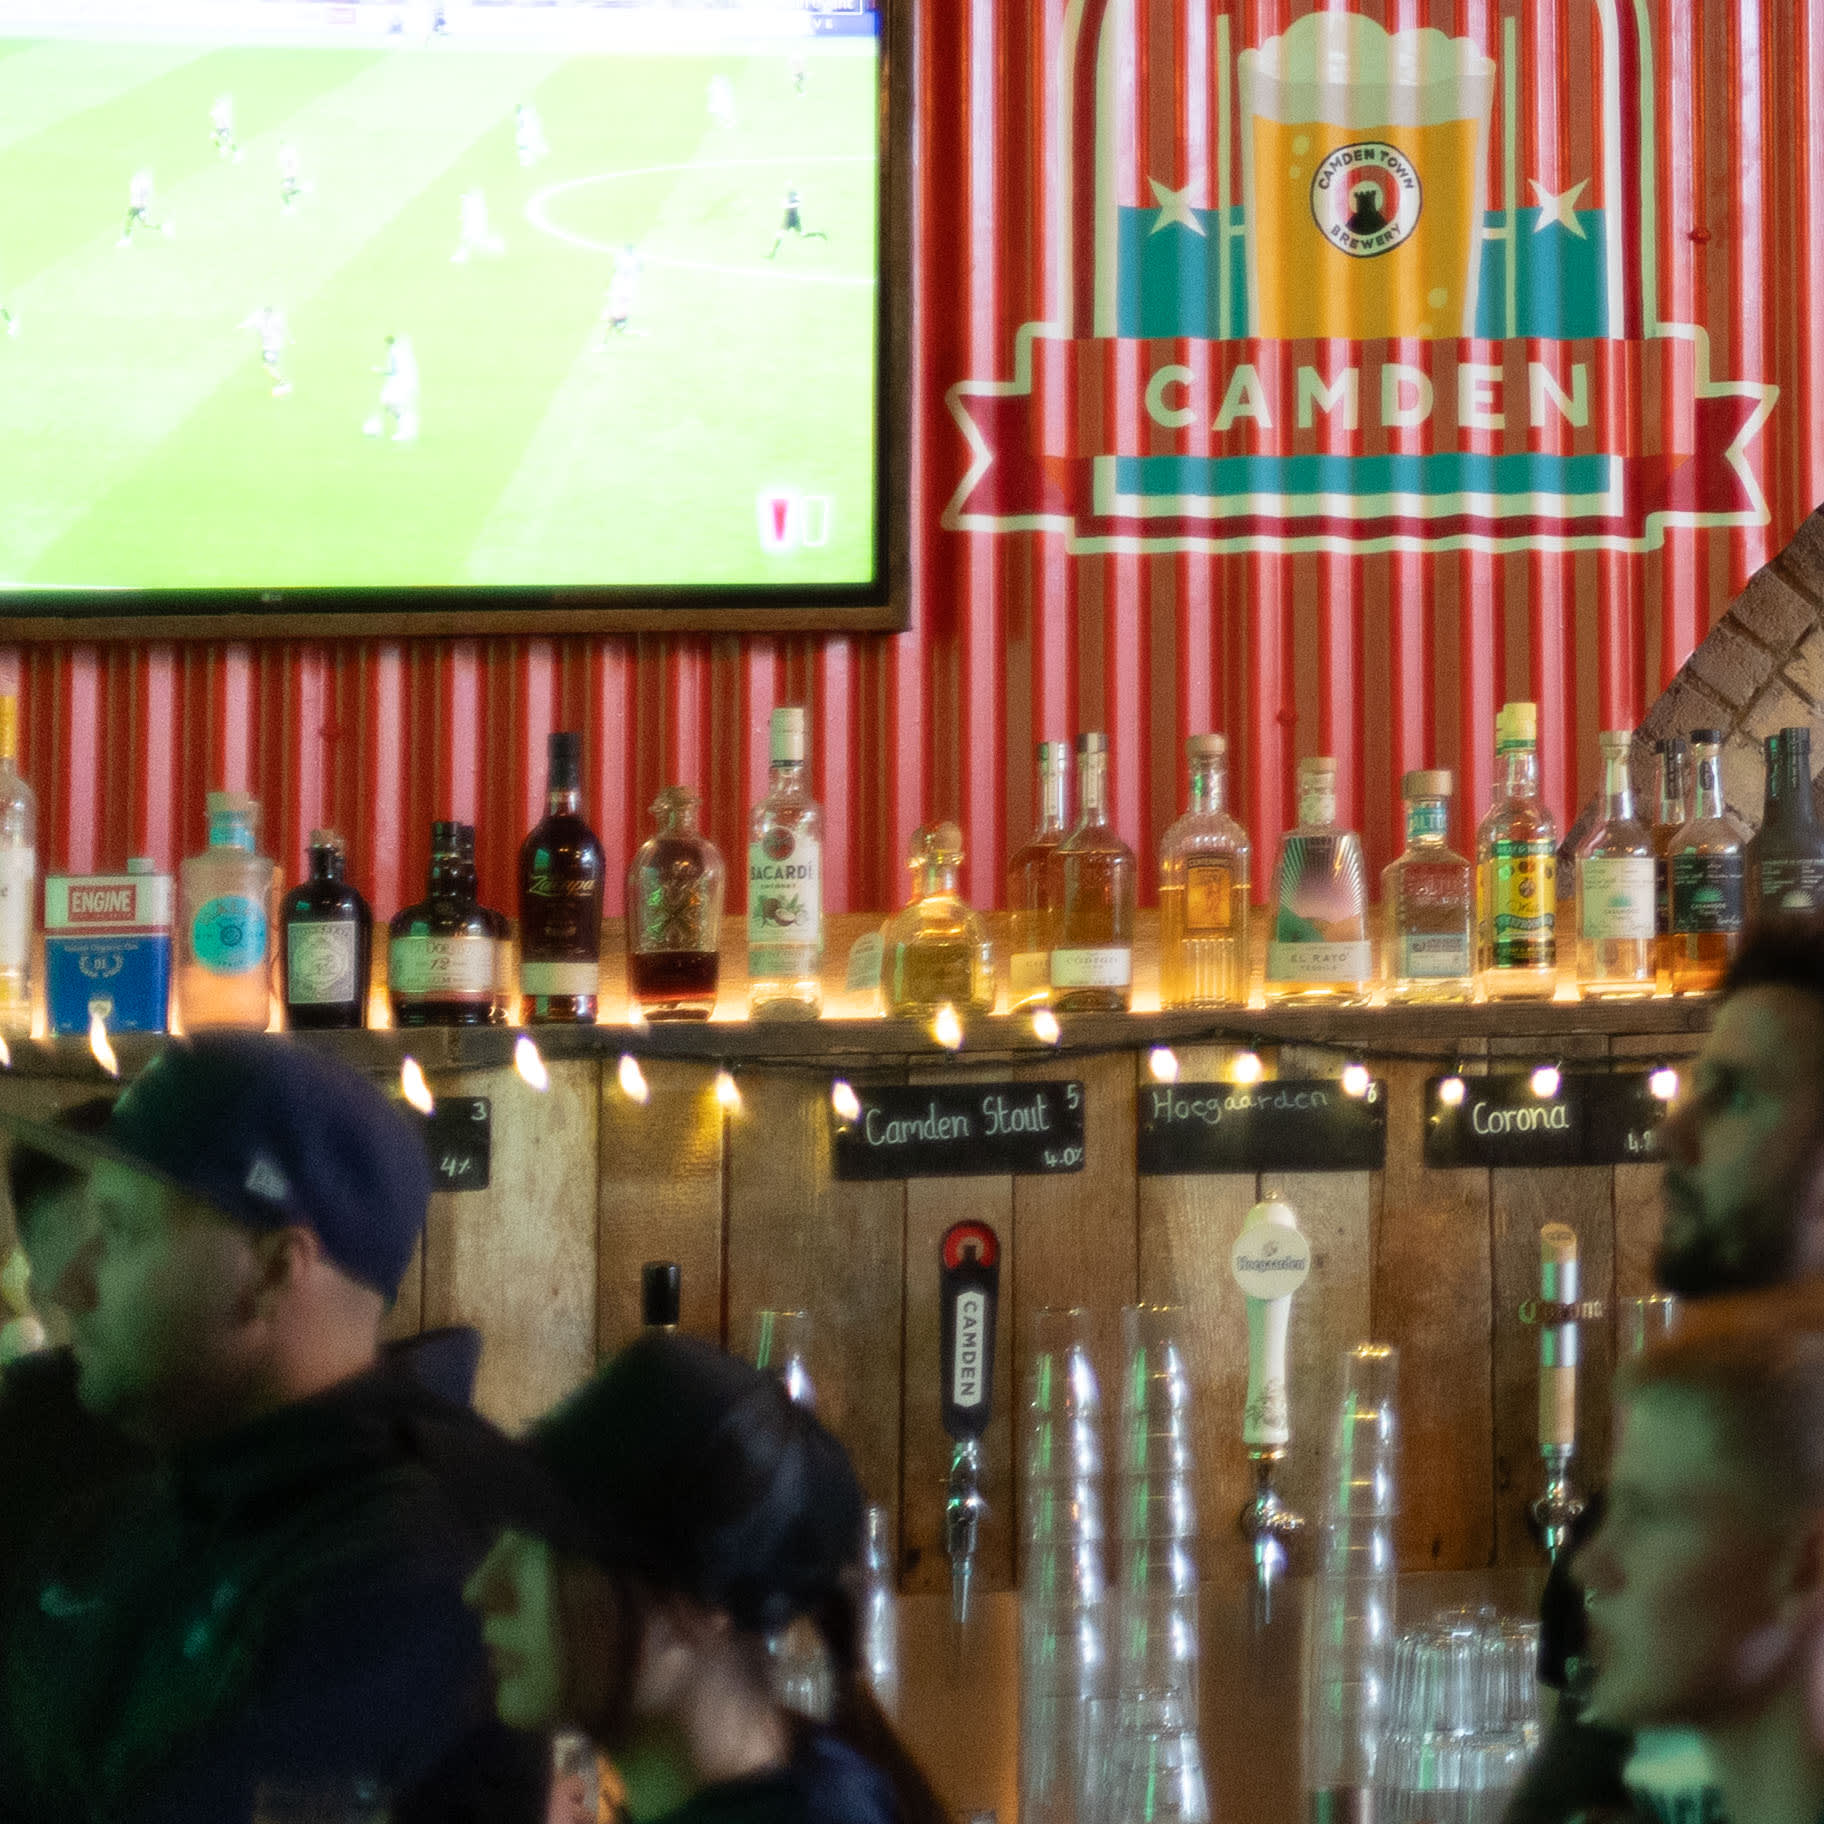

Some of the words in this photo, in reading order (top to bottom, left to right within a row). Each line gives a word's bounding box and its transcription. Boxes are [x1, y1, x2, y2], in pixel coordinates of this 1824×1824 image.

[1318, 148, 1375, 191] CAMDEN
[1380, 150, 1414, 189] TOWN
[1330, 223, 1402, 249] BREWERY
[1145, 363, 1589, 432] CAMDEN
[71, 889, 131, 914] ENGINE
[1290, 954, 1308, 964] EL
[1312, 952, 1346, 964] RAYO
[470, 1101, 487, 1121] 3
[866, 1102, 969, 1146] Camden
[982, 1093, 1050, 1135] Stout
[1066, 1083, 1079, 1109] 5
[1152, 1089, 1328, 1124] Hoegaarden
[1472, 1101, 1570, 1135] Corona
[1044, 1146, 1083, 1167] 4.0%
[1238, 1256, 1306, 1272] Hoegaarden
[960, 1299, 977, 1397] CAMDEN
